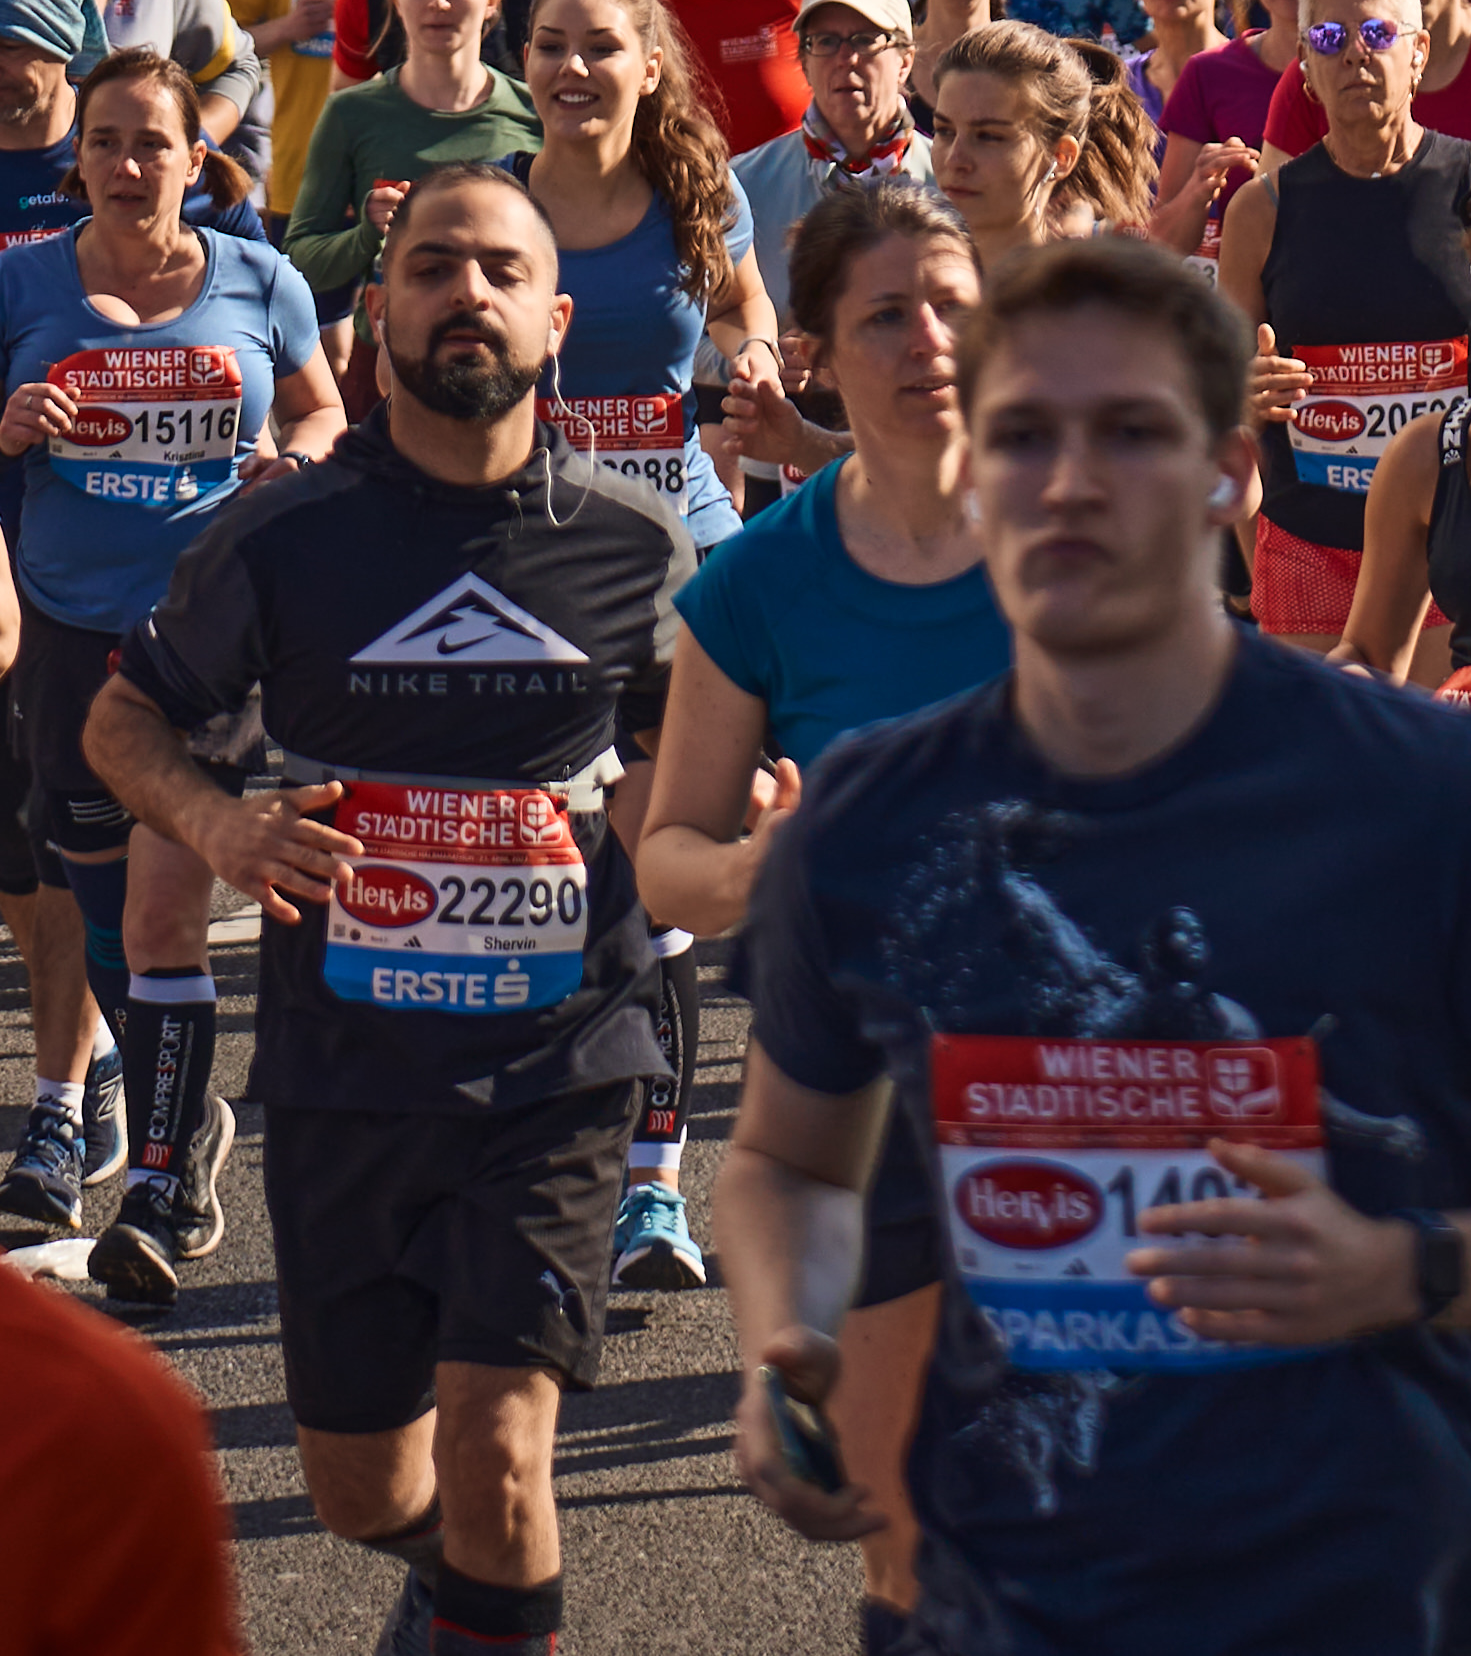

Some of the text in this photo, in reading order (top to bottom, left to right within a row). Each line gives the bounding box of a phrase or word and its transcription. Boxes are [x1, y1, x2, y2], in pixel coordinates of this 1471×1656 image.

[105, 349, 187, 369] WIENER
[1338, 345, 1417, 364] WIENER
[65, 368, 187, 389] STÄDTISCHE
[1308, 362, 1417, 383] STÄDTISCHE
[547, 398, 630, 418] WIENER
[1299, 405, 1362, 433] Hervis
[134, 407, 236, 445] 15116
[557, 417, 630, 437] TISCHE
[85, 470, 171, 502] ERSTE
[348, 671, 588, 694] NIKE TRAIL
[407, 789, 515, 819] WIENER
[356, 810, 515, 846] STÄDTISCHE
[345, 874, 582, 926] Hervis 22290
[483, 936, 537, 951] Shervin
[371, 966, 487, 1007] ERSTE
[1039, 1043, 1202, 1081] WIENER
[966, 1081, 1205, 1119] STÄDTISCHE
[969, 1175, 1093, 1230] Hervis
